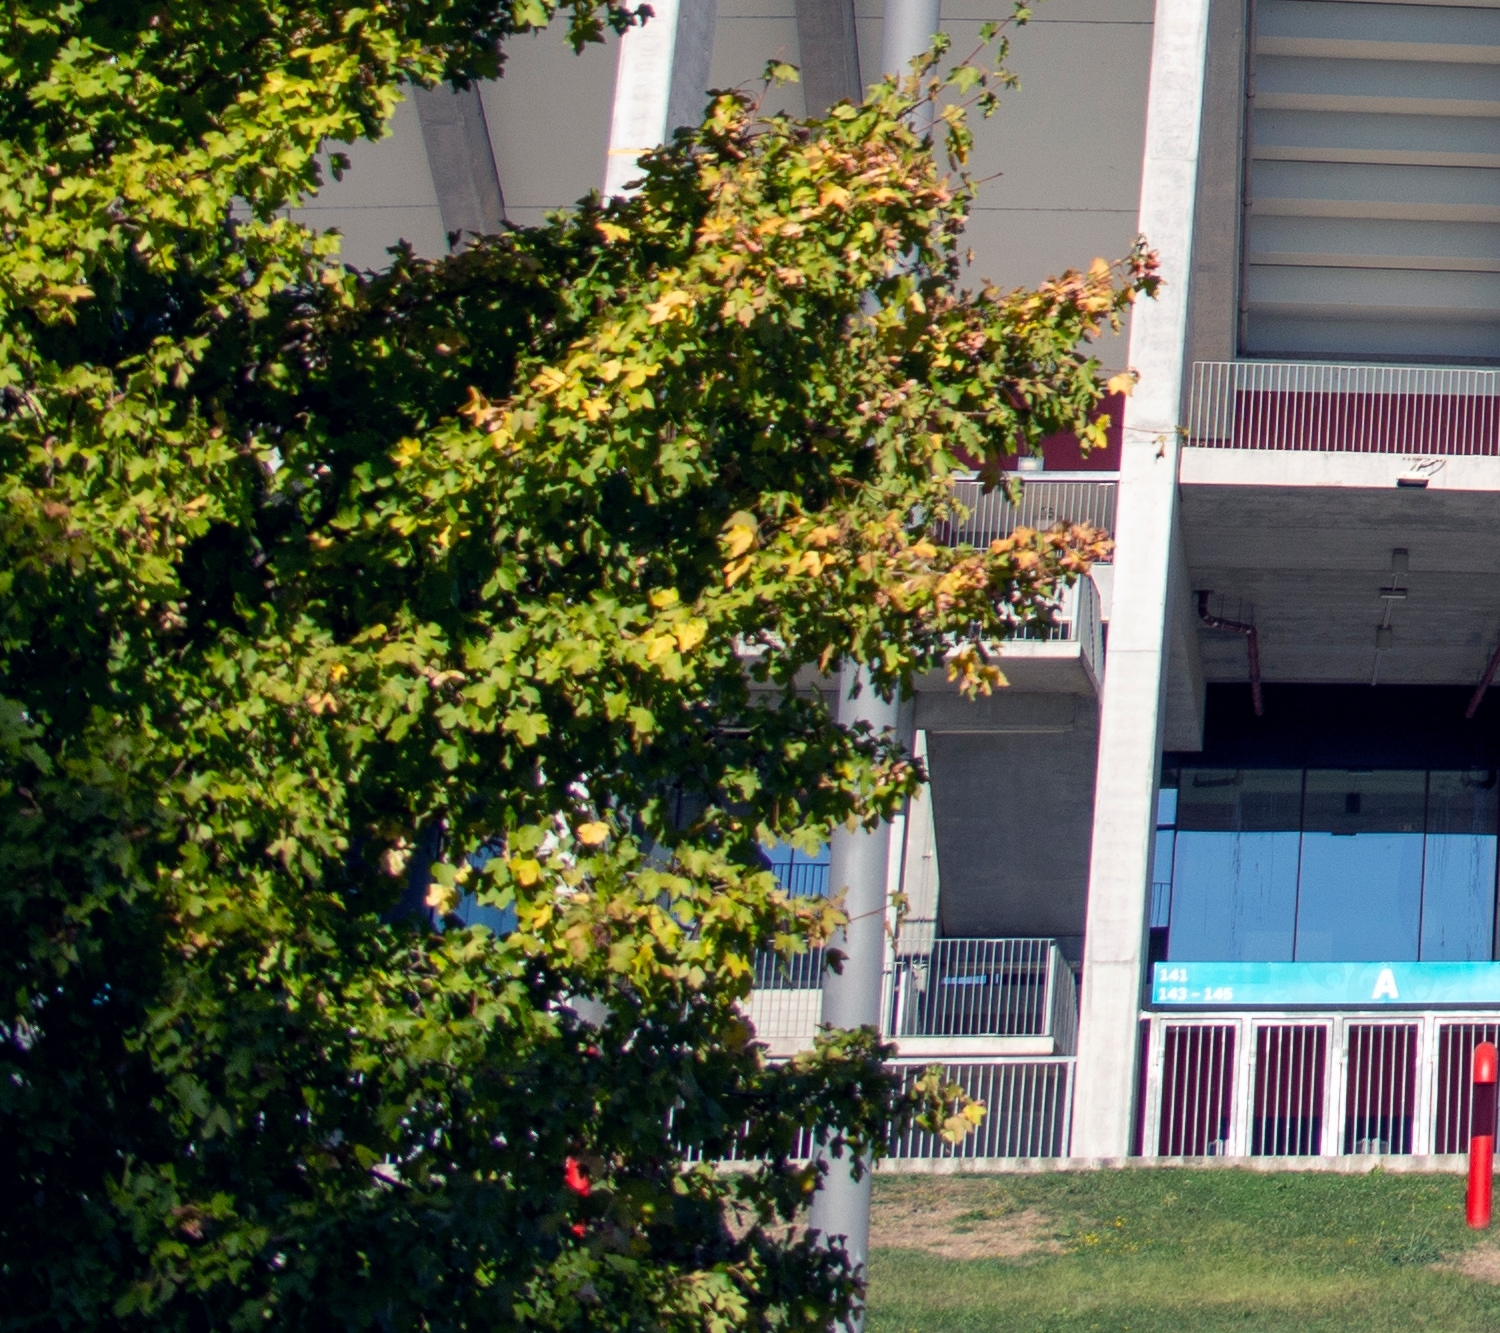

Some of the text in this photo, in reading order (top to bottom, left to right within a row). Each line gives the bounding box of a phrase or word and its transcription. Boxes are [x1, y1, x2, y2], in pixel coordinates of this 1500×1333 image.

[1159, 968, 1188, 982] 141
[1371, 967, 1400, 1000] A
[1158, 987, 1187, 1001] 143
[1204, 987, 1233, 1001] 145
